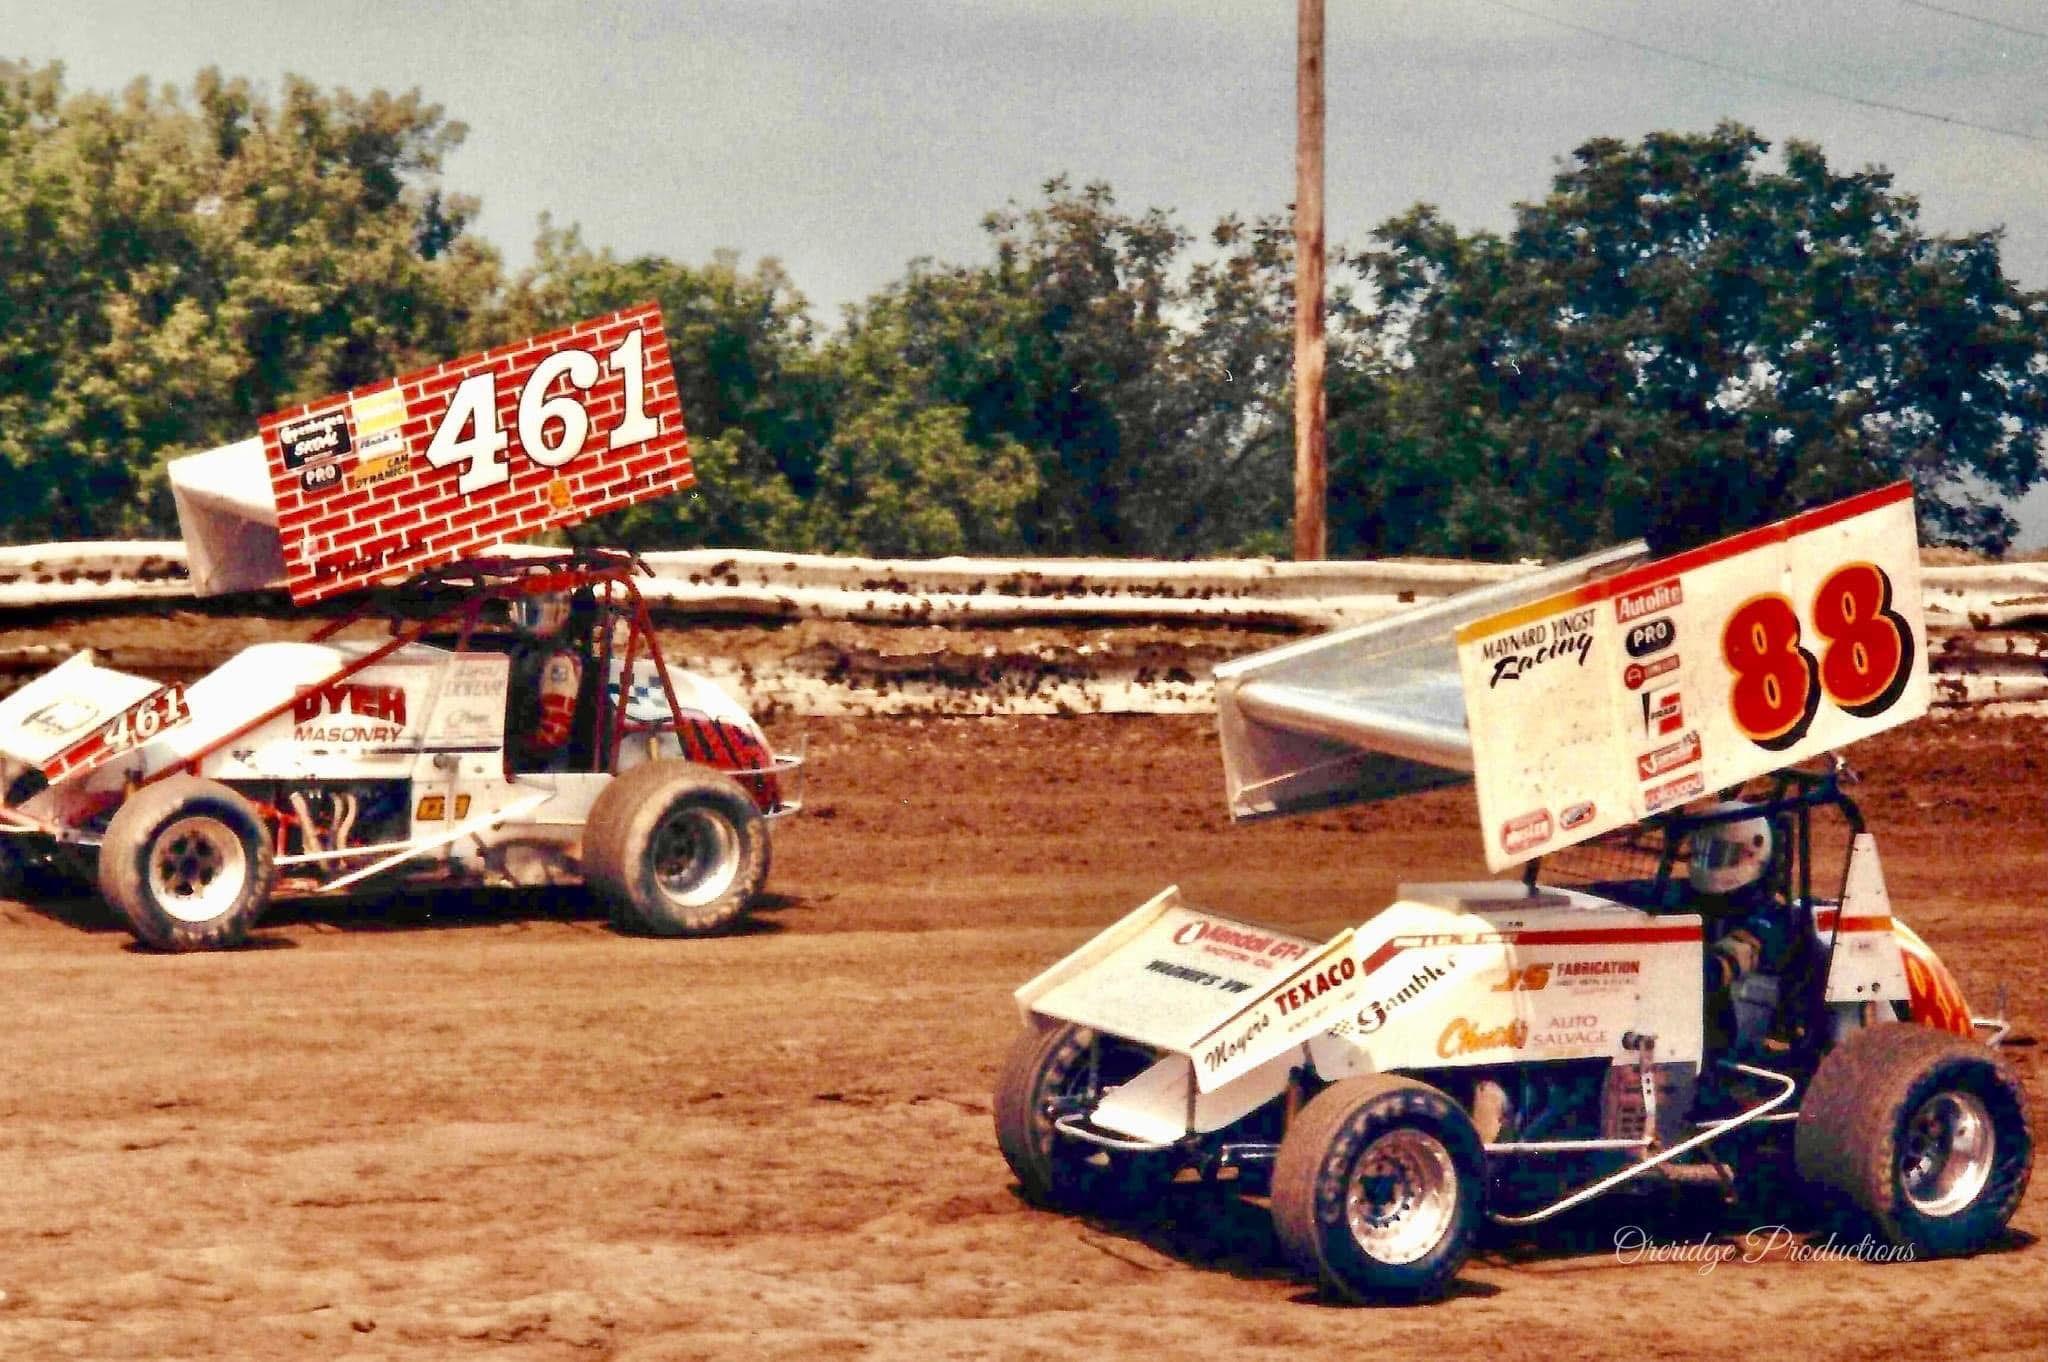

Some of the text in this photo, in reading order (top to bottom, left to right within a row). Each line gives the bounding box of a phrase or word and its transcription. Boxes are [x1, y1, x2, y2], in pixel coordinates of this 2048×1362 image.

[425, 327, 661, 496] 461
[305, 464, 336, 486] PRO
[1619, 585, 1681, 621] Autolite
[1482, 624, 1546, 661] MAYNARD
[1633, 622, 1667, 648] PRO
[1490, 633, 1594, 690] Racing
[1720, 560, 1915, 751] 88
[103, 686, 184, 749] 461
[294, 726, 403, 743] MASONRY
[1556, 960, 1640, 977] FABRICATION
[1274, 957, 1356, 1017] TEXACO
[1533, 1030, 1608, 1047] SALVAGE
[1549, 1014, 1599, 1030] AUTO
